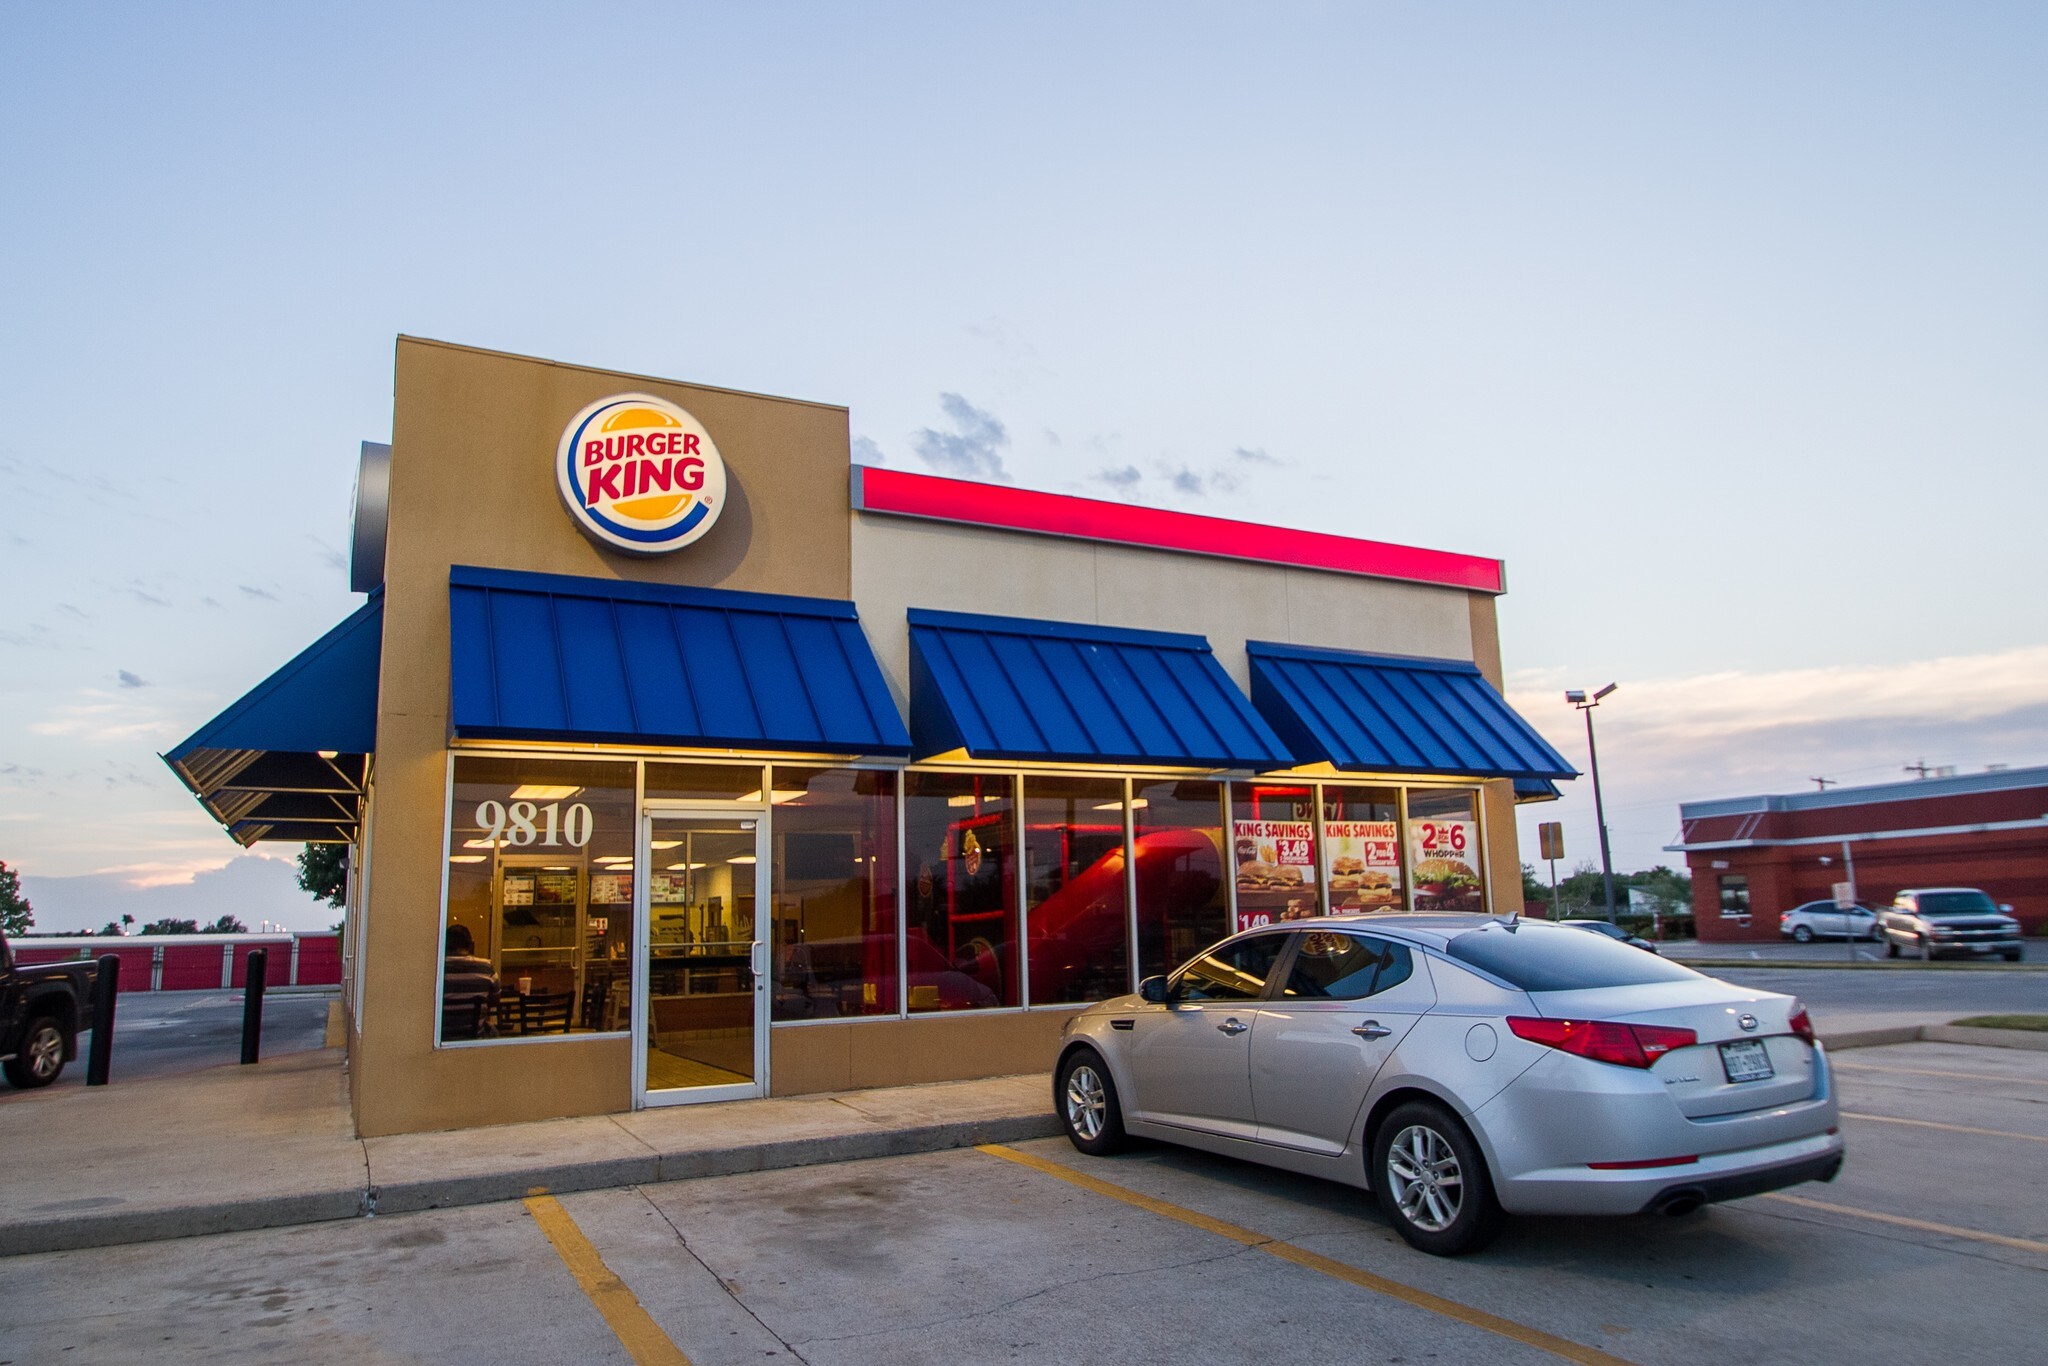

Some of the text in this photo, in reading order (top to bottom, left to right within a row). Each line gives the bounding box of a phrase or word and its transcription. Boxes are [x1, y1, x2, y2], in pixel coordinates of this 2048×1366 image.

[584, 432, 701, 468] BURGER
[587, 457, 705, 506] KING
[474, 800, 594, 848] 9810
[1422, 823, 1437, 849] 2
[1367, 842, 1377, 860] 2
[1423, 850, 1465, 858] WHOPPER
